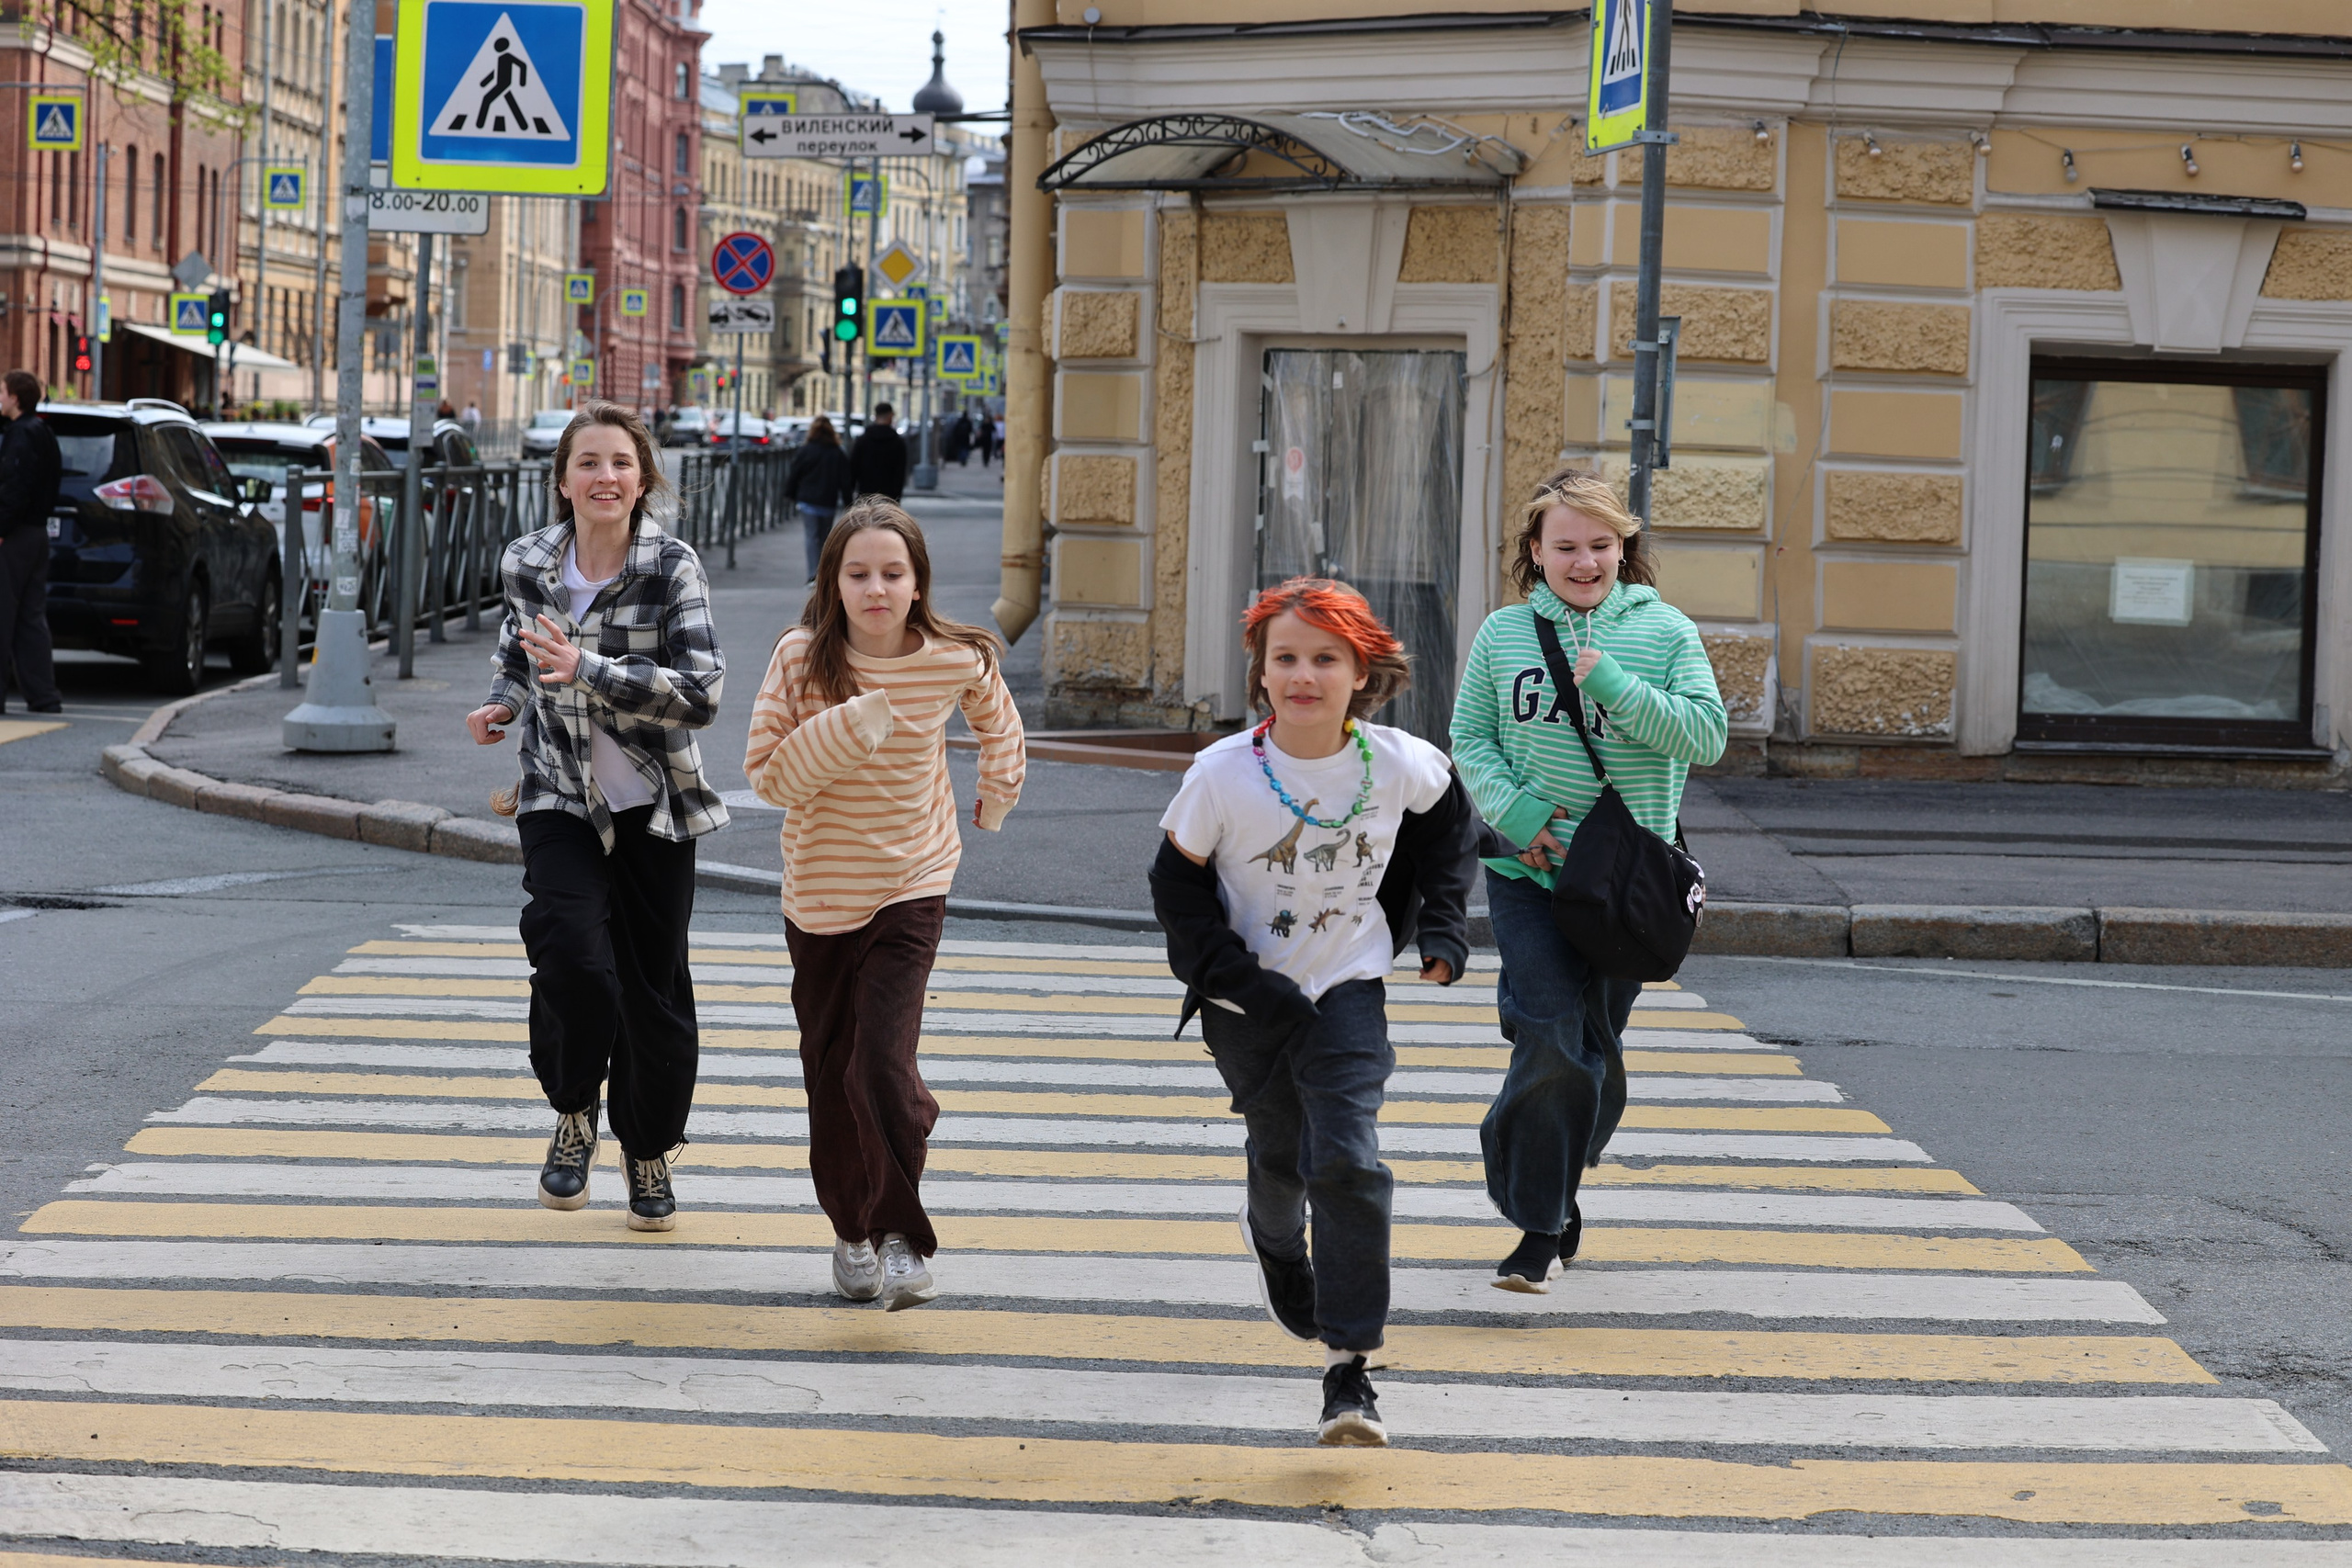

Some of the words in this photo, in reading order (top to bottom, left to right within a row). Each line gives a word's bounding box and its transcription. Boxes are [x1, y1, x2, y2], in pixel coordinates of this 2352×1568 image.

[782, 118, 894, 134] ВИЛЕНСКИЙ
[797, 141, 877, 155] переулок
[371, 191, 479, 213] 8.00-20.00
